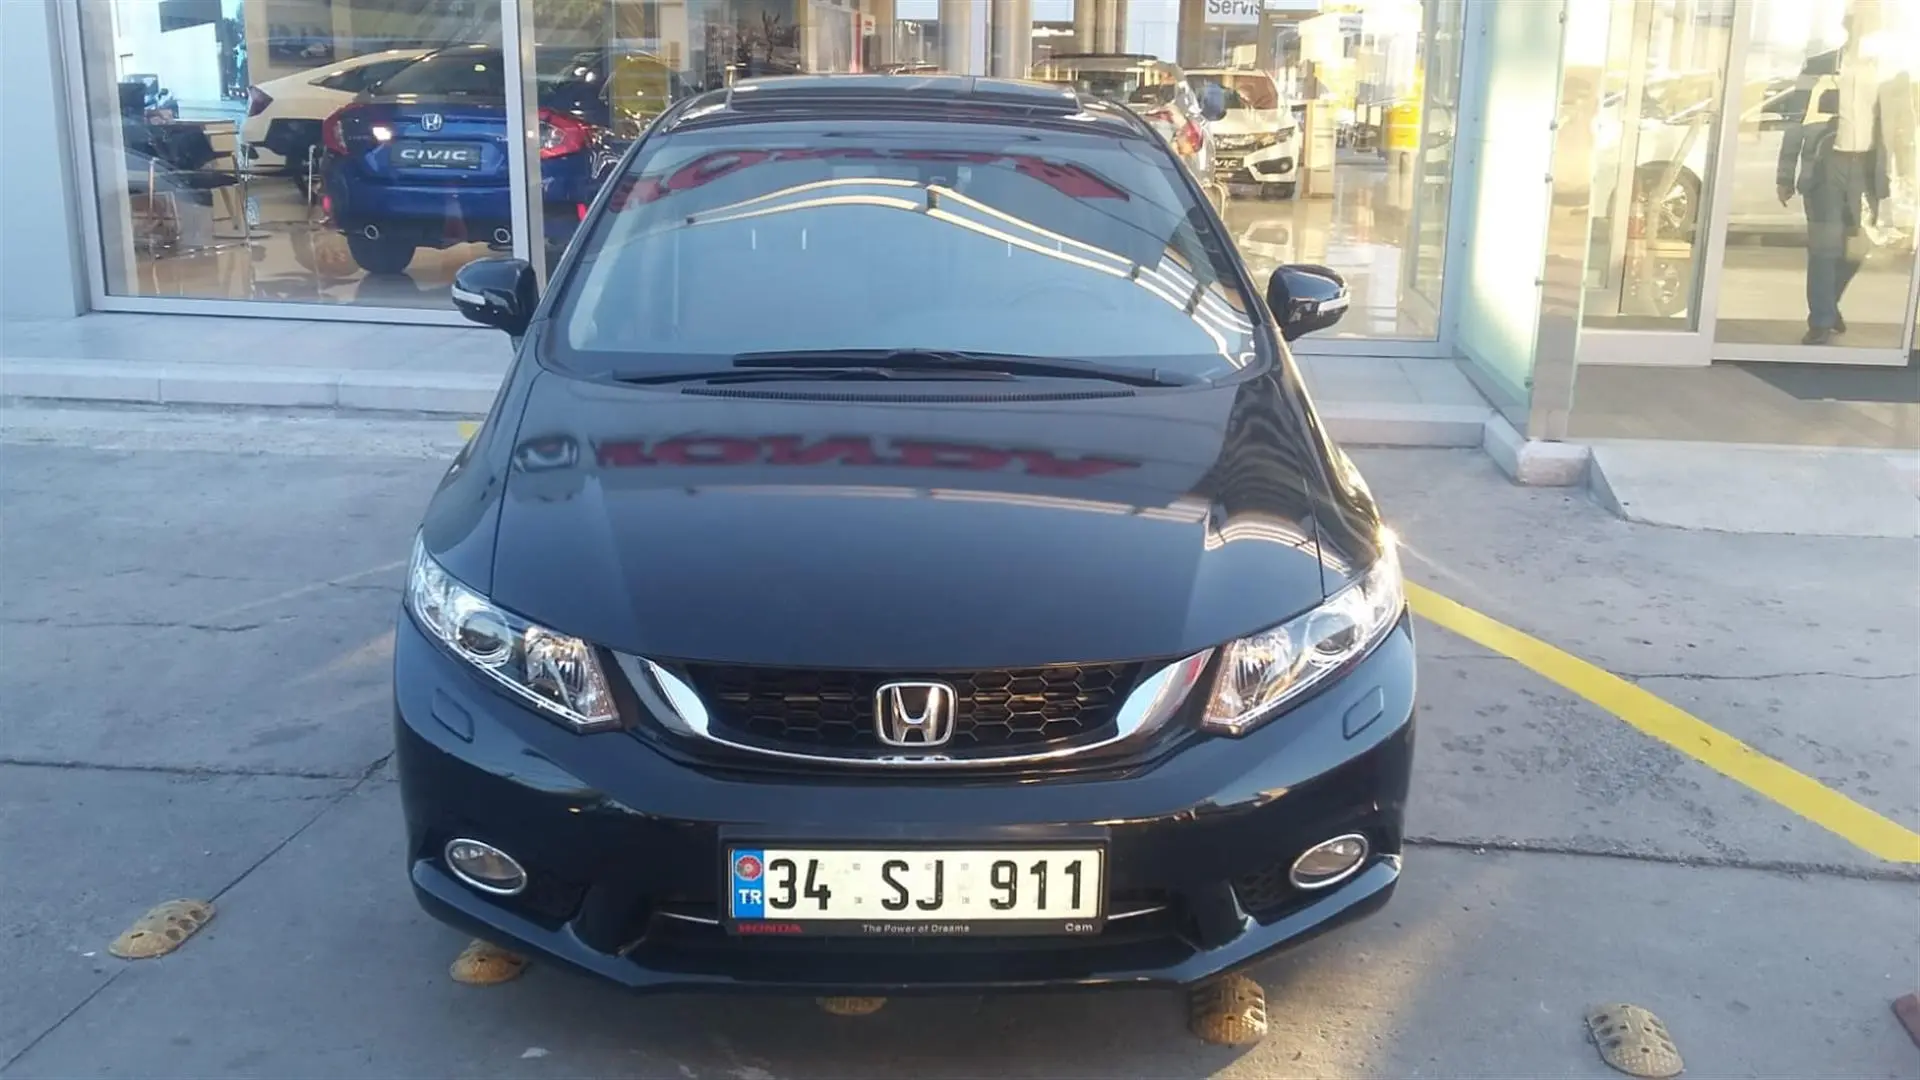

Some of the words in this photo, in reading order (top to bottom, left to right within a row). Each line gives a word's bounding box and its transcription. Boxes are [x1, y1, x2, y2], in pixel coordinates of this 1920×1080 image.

[400, 148, 467, 160] CIVIC
[1214, 159, 1238, 167] VIC
[768, 858, 832, 911] 34
[881, 859, 944, 911] SJ
[990, 859, 1082, 911] 911
[738, 888, 763, 905] TR
[736, 923, 803, 933] HONDA
[863, 923, 882, 933] The
[884, 923, 916, 933] Power
[918, 923, 929, 933] of
[931, 923, 970, 933] Dreams
